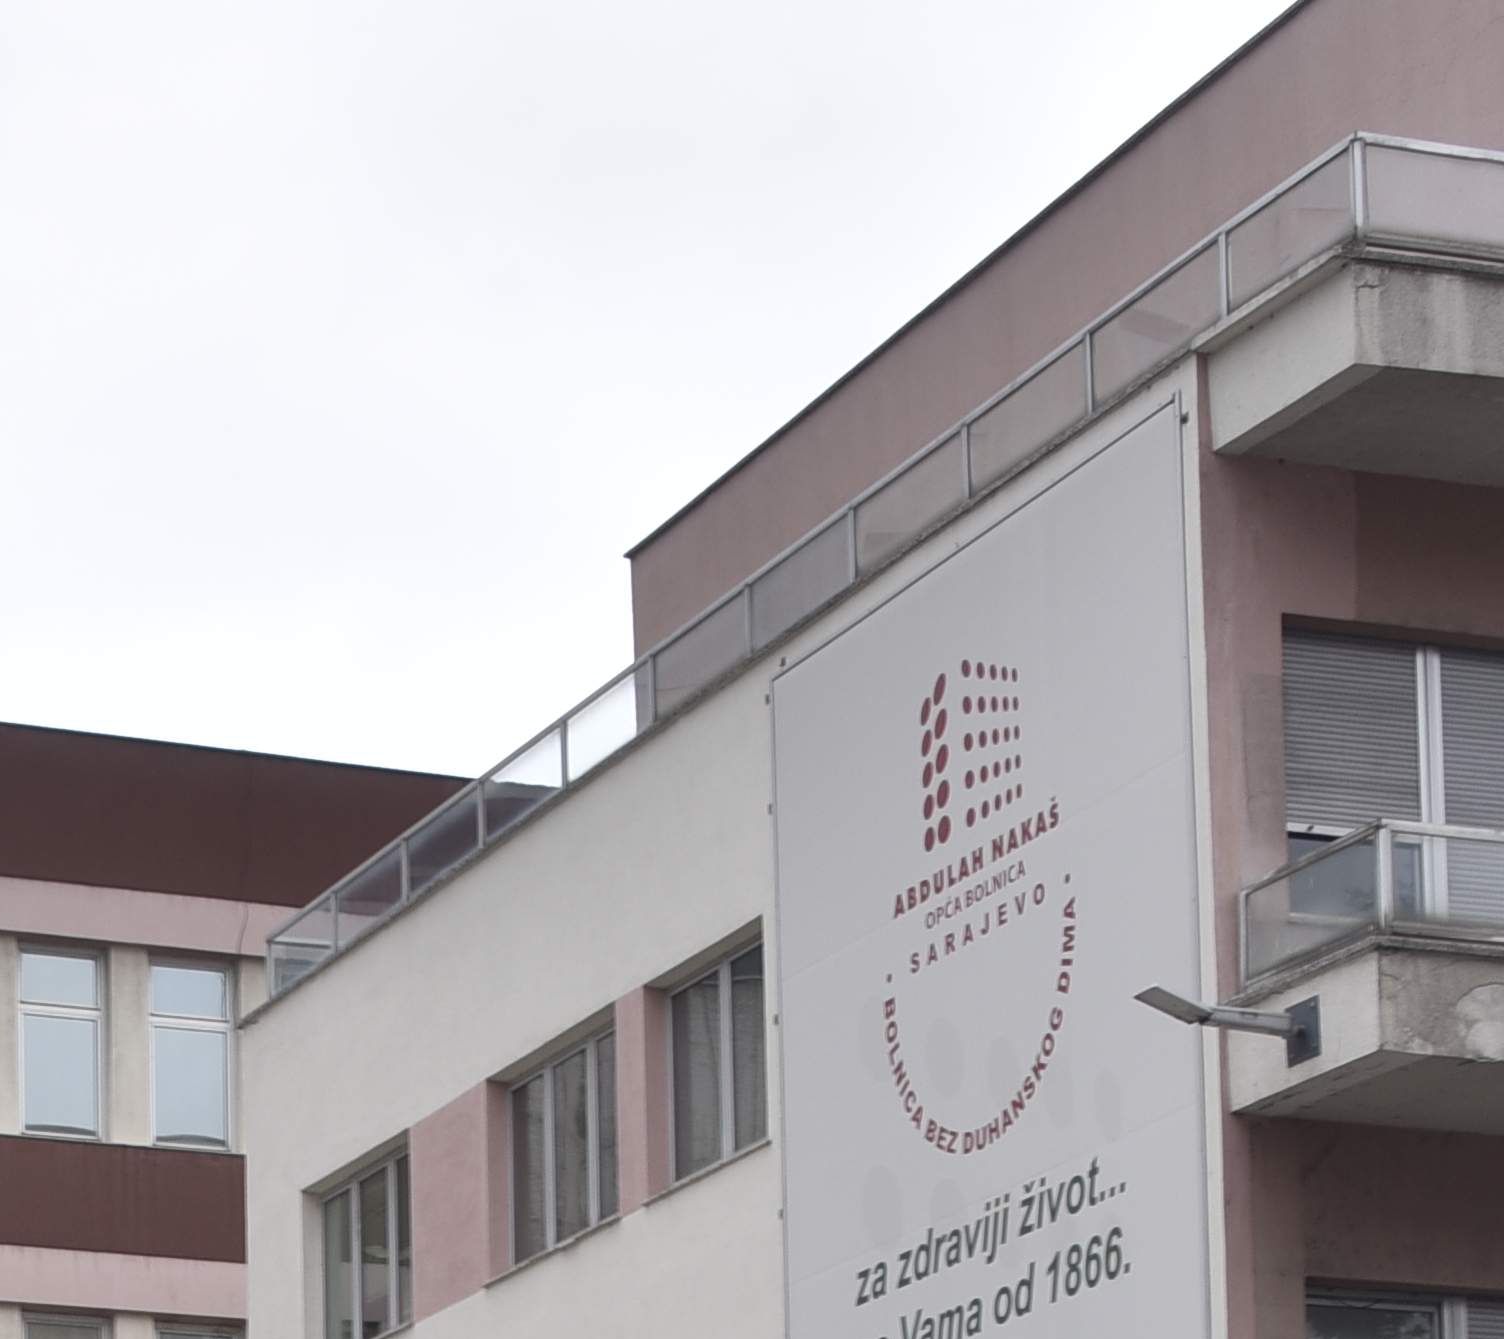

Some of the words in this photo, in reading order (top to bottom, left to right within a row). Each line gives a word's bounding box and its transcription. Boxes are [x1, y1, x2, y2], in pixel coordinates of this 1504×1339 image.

[892, 846, 984, 919] ABDULAH
[990, 796, 1060, 863] NAKAŠ
[964, 860, 1026, 908] BOLNICA
[909, 882, 1045, 974] SARAJEVO
[883, 997, 924, 1130] BOLNICA
[924, 1117, 959, 1155] BEZ
[962, 1006, 1064, 1155] DUHANSKOG
[1056, 896, 1077, 994] DIMA
[855, 1260, 888, 1308] za
[896, 1192, 1011, 1290] zdraviji
[993, 1261, 1036, 1325] od
[1045, 1225, 1132, 1304] 1866.
